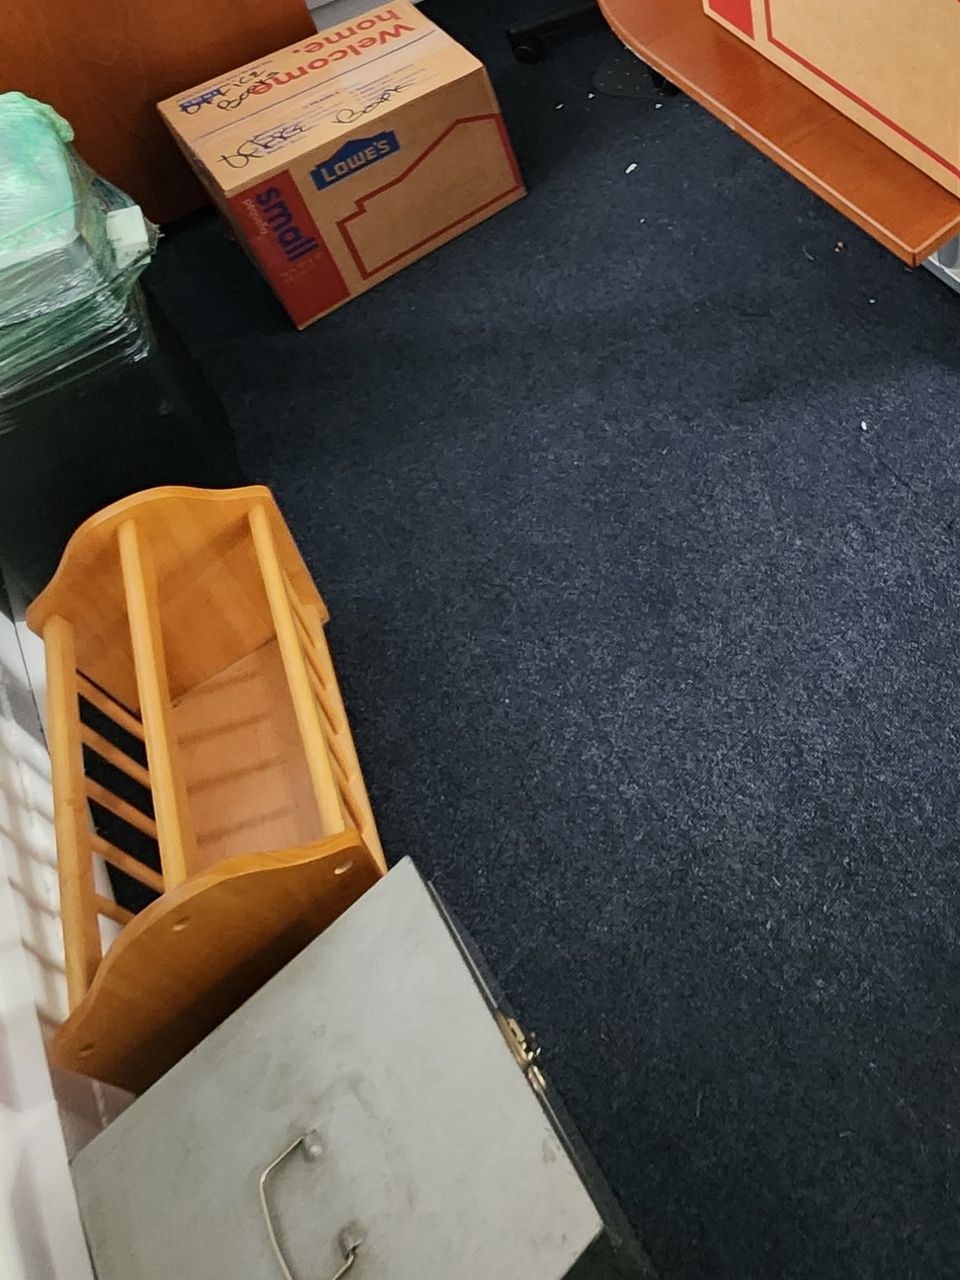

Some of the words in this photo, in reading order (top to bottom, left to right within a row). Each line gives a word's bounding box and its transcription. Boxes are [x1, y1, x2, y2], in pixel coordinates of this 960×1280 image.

[252, 23, 416, 96] Welcome
[293, 9, 401, 55] home.
[320, 139, 391, 183] LOWE'S
[255, 185, 319, 262] small
